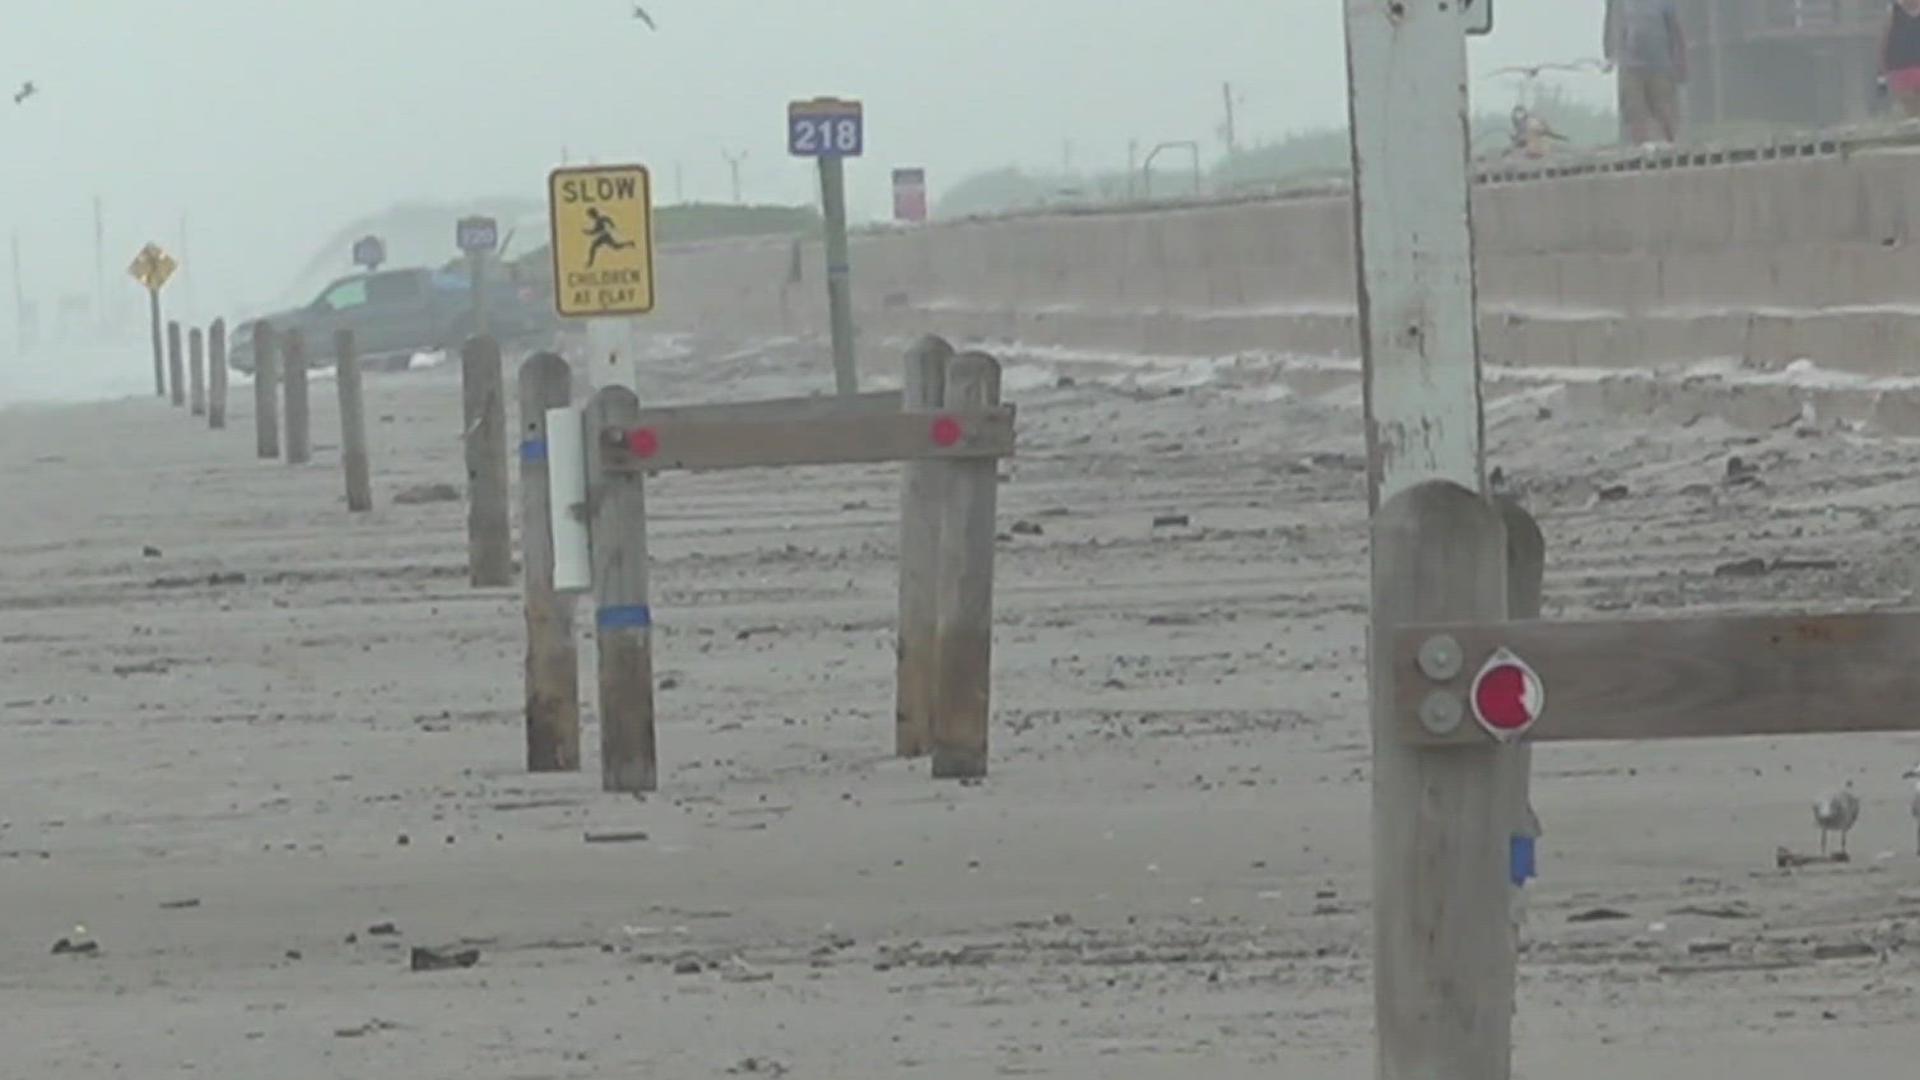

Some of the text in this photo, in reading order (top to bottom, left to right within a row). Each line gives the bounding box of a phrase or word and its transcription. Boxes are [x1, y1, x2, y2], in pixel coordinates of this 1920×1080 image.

[795, 120, 856, 151] 218
[562, 177, 636, 203] SLOW
[573, 290, 591, 305] AT
